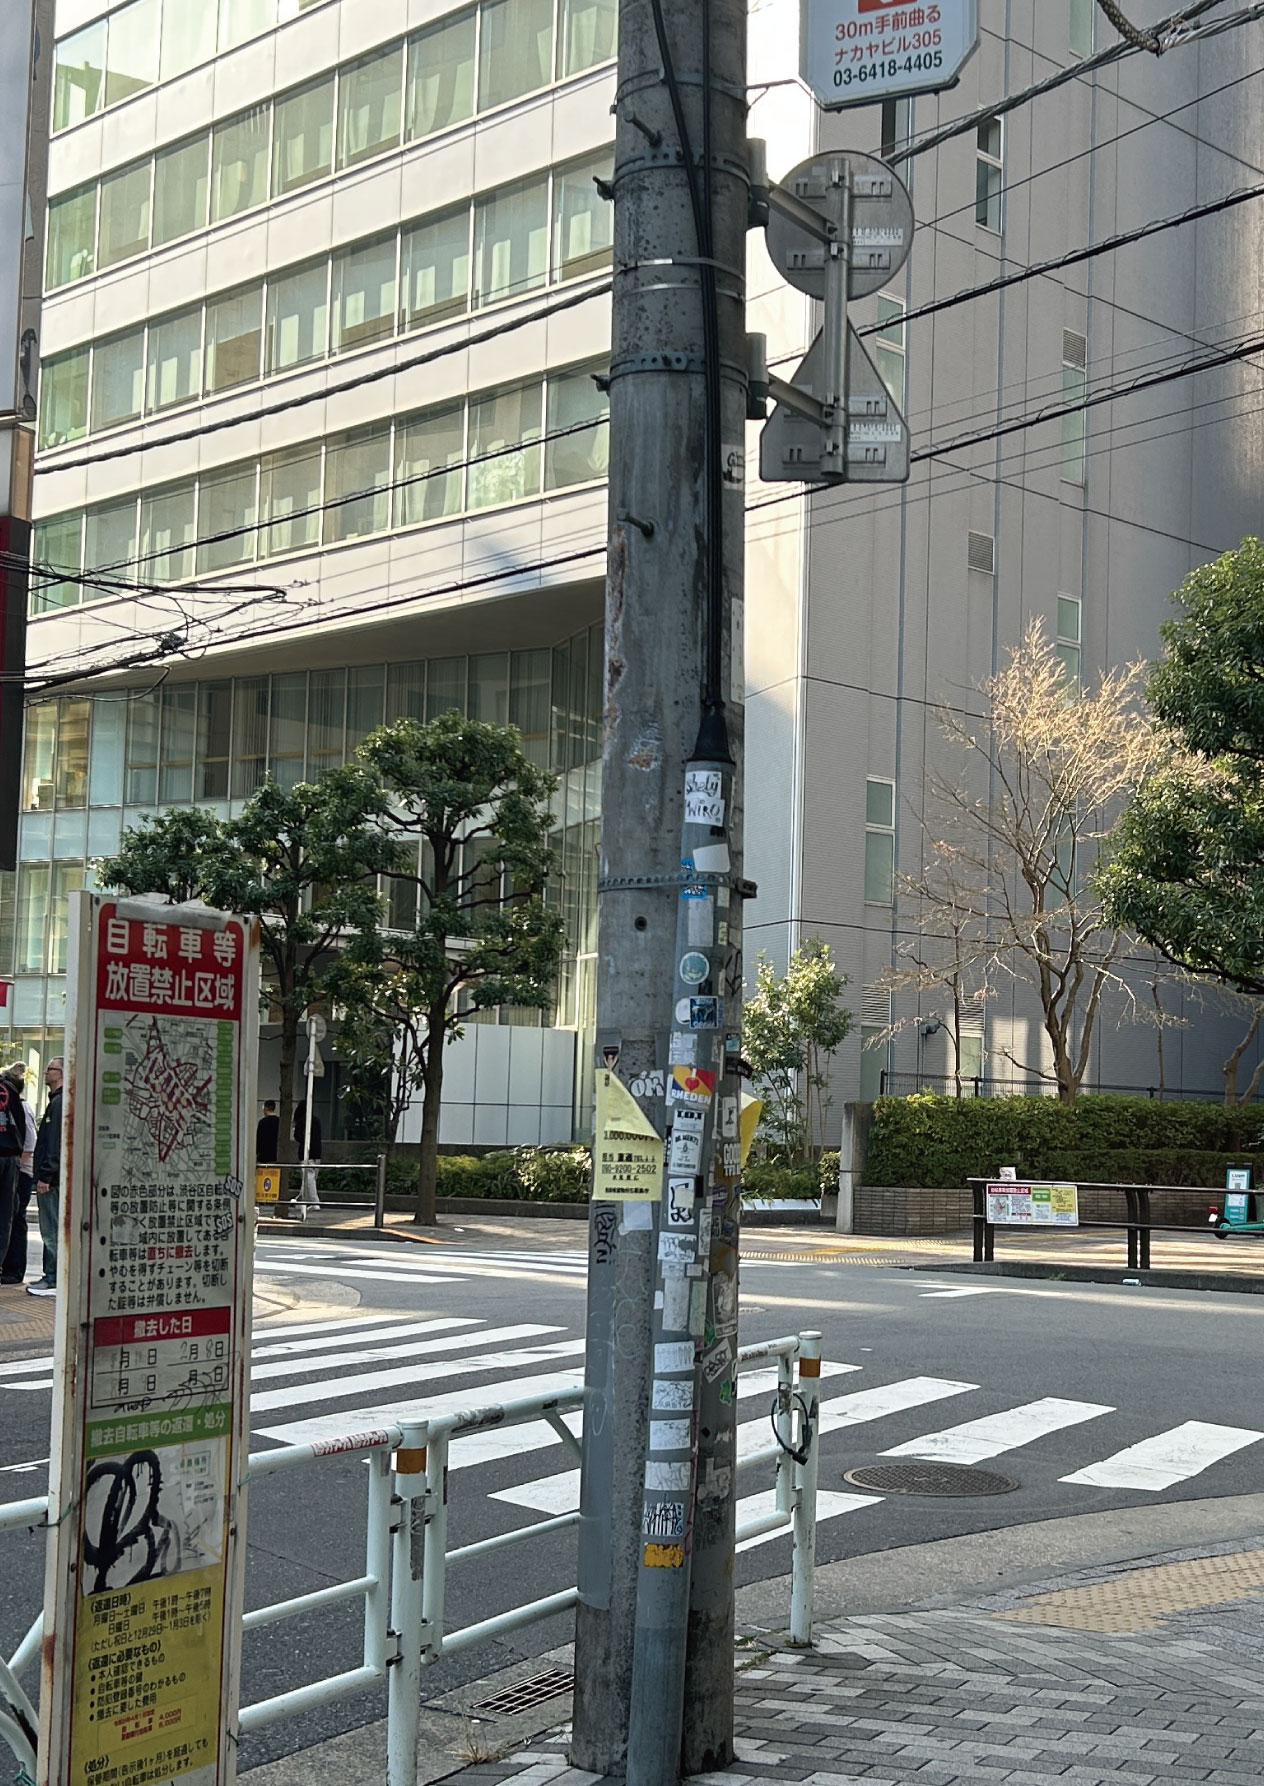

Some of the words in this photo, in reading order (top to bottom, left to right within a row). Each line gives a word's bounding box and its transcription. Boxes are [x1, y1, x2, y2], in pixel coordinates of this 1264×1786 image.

[835, 4, 942, 42] 30m手前曲る
[834, 28, 942, 66] ナカヤビル305
[833, 49, 943, 87] 03-6418-4405
[106, 917, 237, 968] 自転車等
[105, 960, 236, 1011] 放置禁止区域
[110, 1183, 228, 1199] 図の赤色部分は、渋谷区自転
[109, 1258, 229, 1278] やむを得ずチェーン等を切断
[134, 1316, 192, 1338] 撤去した日
[108, 1619, 130, 1635] 日曜日
